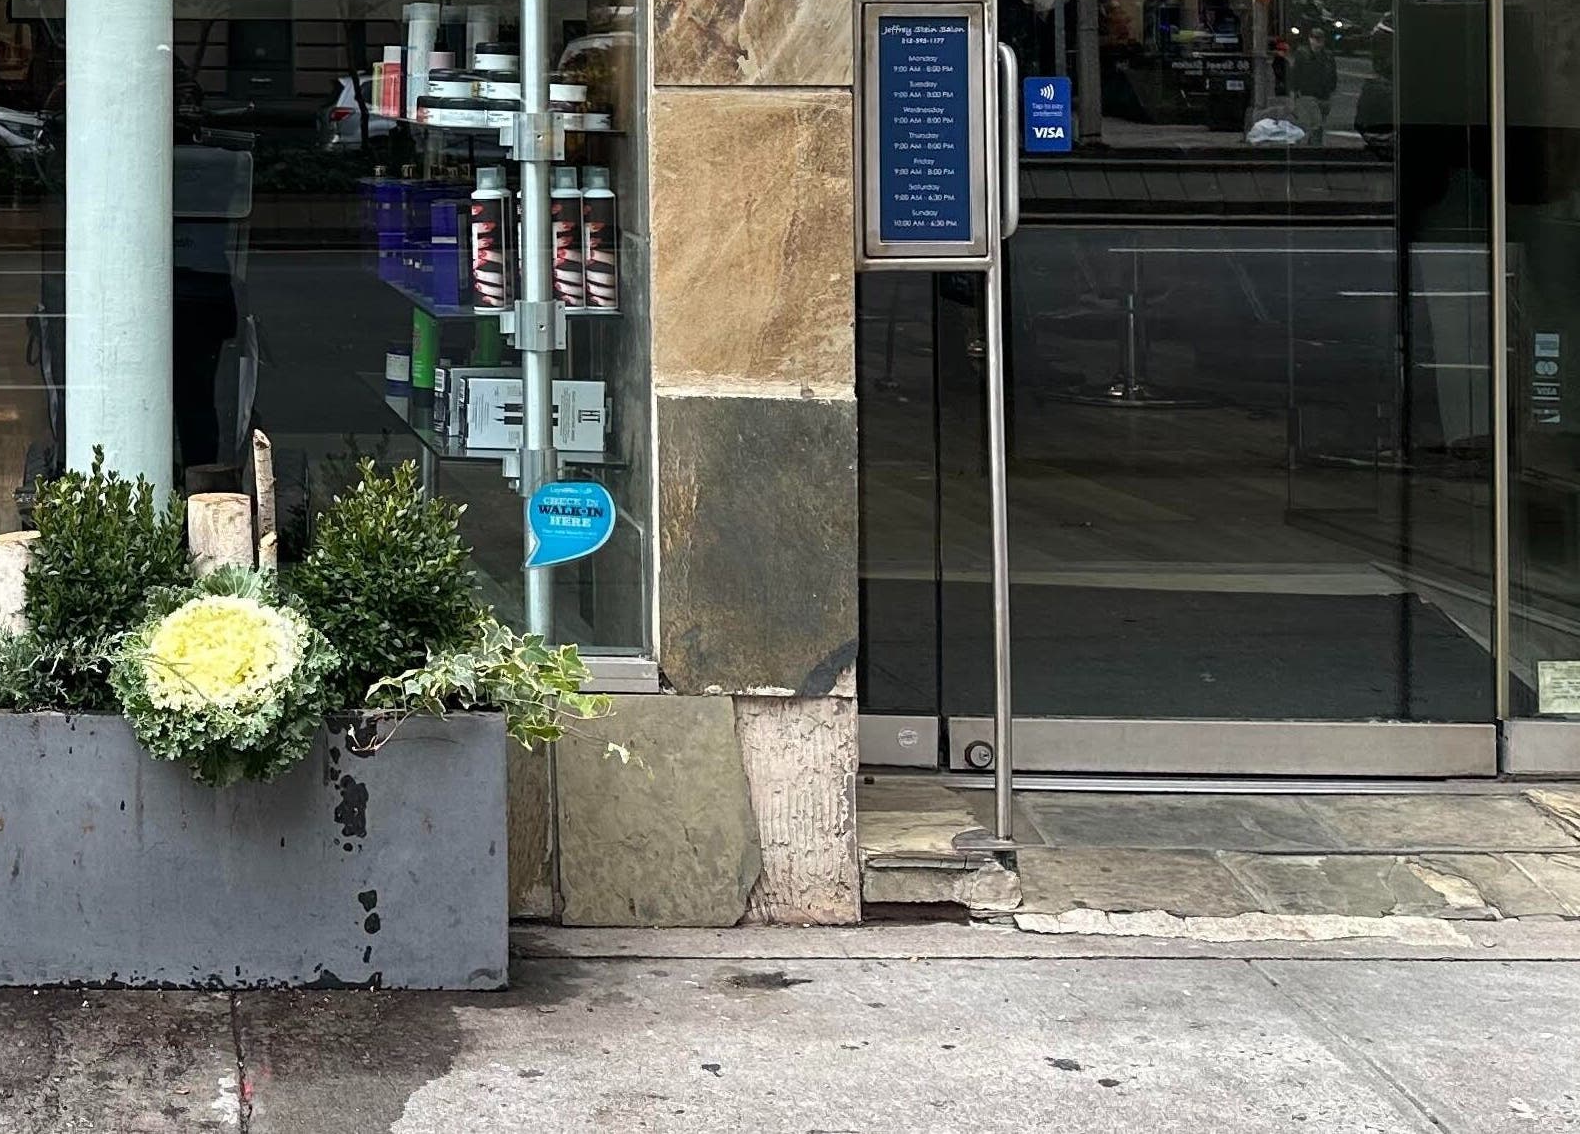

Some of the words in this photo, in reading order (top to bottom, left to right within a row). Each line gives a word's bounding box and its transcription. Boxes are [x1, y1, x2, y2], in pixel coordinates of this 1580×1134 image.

[882, 24, 912, 37] Jeffrey
[938, 25, 966, 34] Salon
[908, 55, 938, 63] Monday
[903, 106, 945, 114] Wednesday
[1032, 126, 1065, 139] VISA
[913, 157, 935, 165] Friday
[908, 183, 941, 191] Saturday
[911, 209, 939, 217] Sunday
[542, 496, 581, 506] CHECK
[585, 498, 600, 507] IN
[538, 505, 604, 518] WALK-IN
[549, 515, 592, 528] HERE
